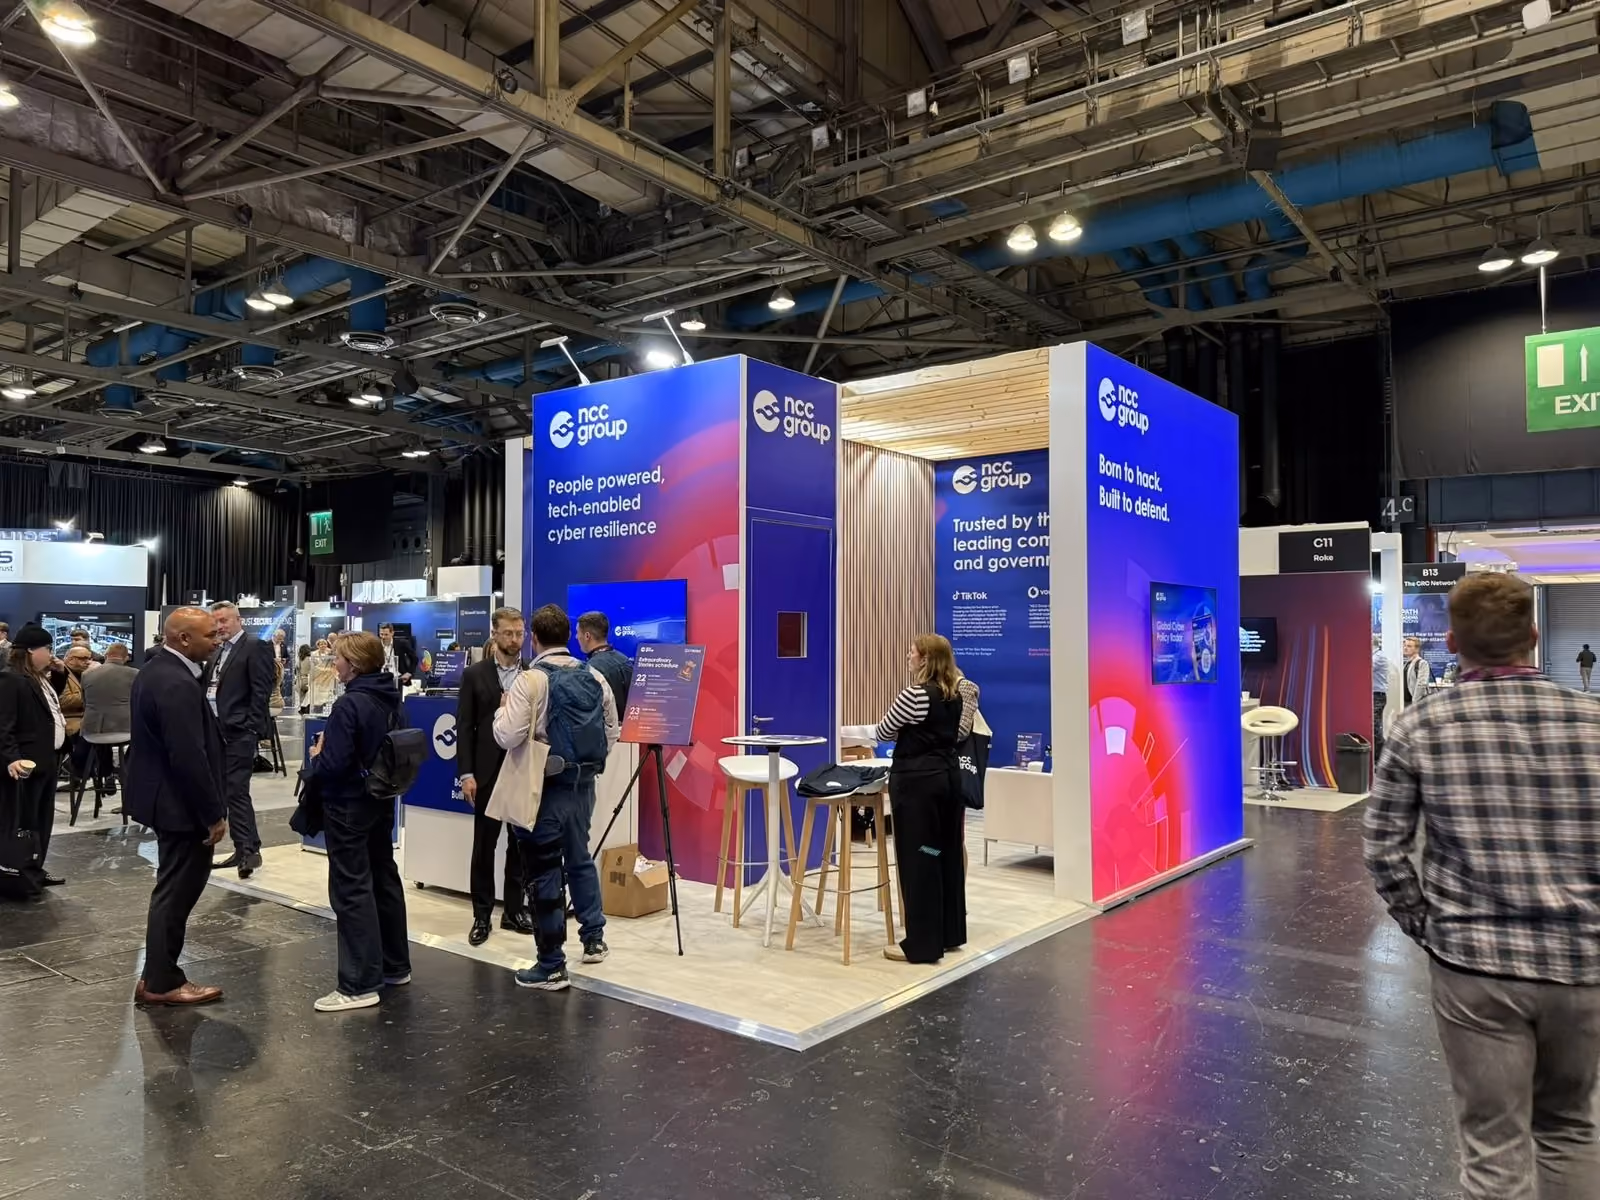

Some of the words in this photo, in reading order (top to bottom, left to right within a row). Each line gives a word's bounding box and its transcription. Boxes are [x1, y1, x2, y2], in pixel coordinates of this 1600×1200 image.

[1118, 384, 1139, 409] ncc
[578, 404, 609, 424] ncc
[785, 396, 814, 419] ncc
[1117, 404, 1149, 436] group
[577, 418, 628, 446] group
[783, 415, 831, 445] group
[981, 461, 1013, 476] ncc
[1099, 453, 1122, 480] Born
[1124, 462, 1134, 483] to
[1136, 465, 1163, 492] hack.
[548, 475, 593, 496] People
[597, 465, 665, 493] powered,
[980, 472, 1032, 493] group
[548, 493, 641, 518] tech-enabled
[1099, 485, 1121, 510] Built
[1122, 492, 1133, 513] to
[1134, 496, 1170, 522] defend.
[548, 525, 586, 545] cyber
[590, 520, 657, 539] resilience
[953, 514, 1007, 533] Trusted
[1012, 514, 1033, 532] by
[315, 538, 327, 548] EXIT
[953, 535, 1012, 552] leading
[1313, 537, 1333, 548] C11
[953, 555, 983, 570] and
[1313, 554, 1334, 562] Roke
[1422, 568, 1439, 577] B13
[960, 592, 987, 600] TikTok
[1157, 620, 1171, 631] Global
[1172, 621, 1185, 632] Cyber
[1157, 632, 1170, 643] Policy
[636, 674, 647, 682] 22
[630, 706, 640, 715] 23
[959, 762, 978, 775] roup
